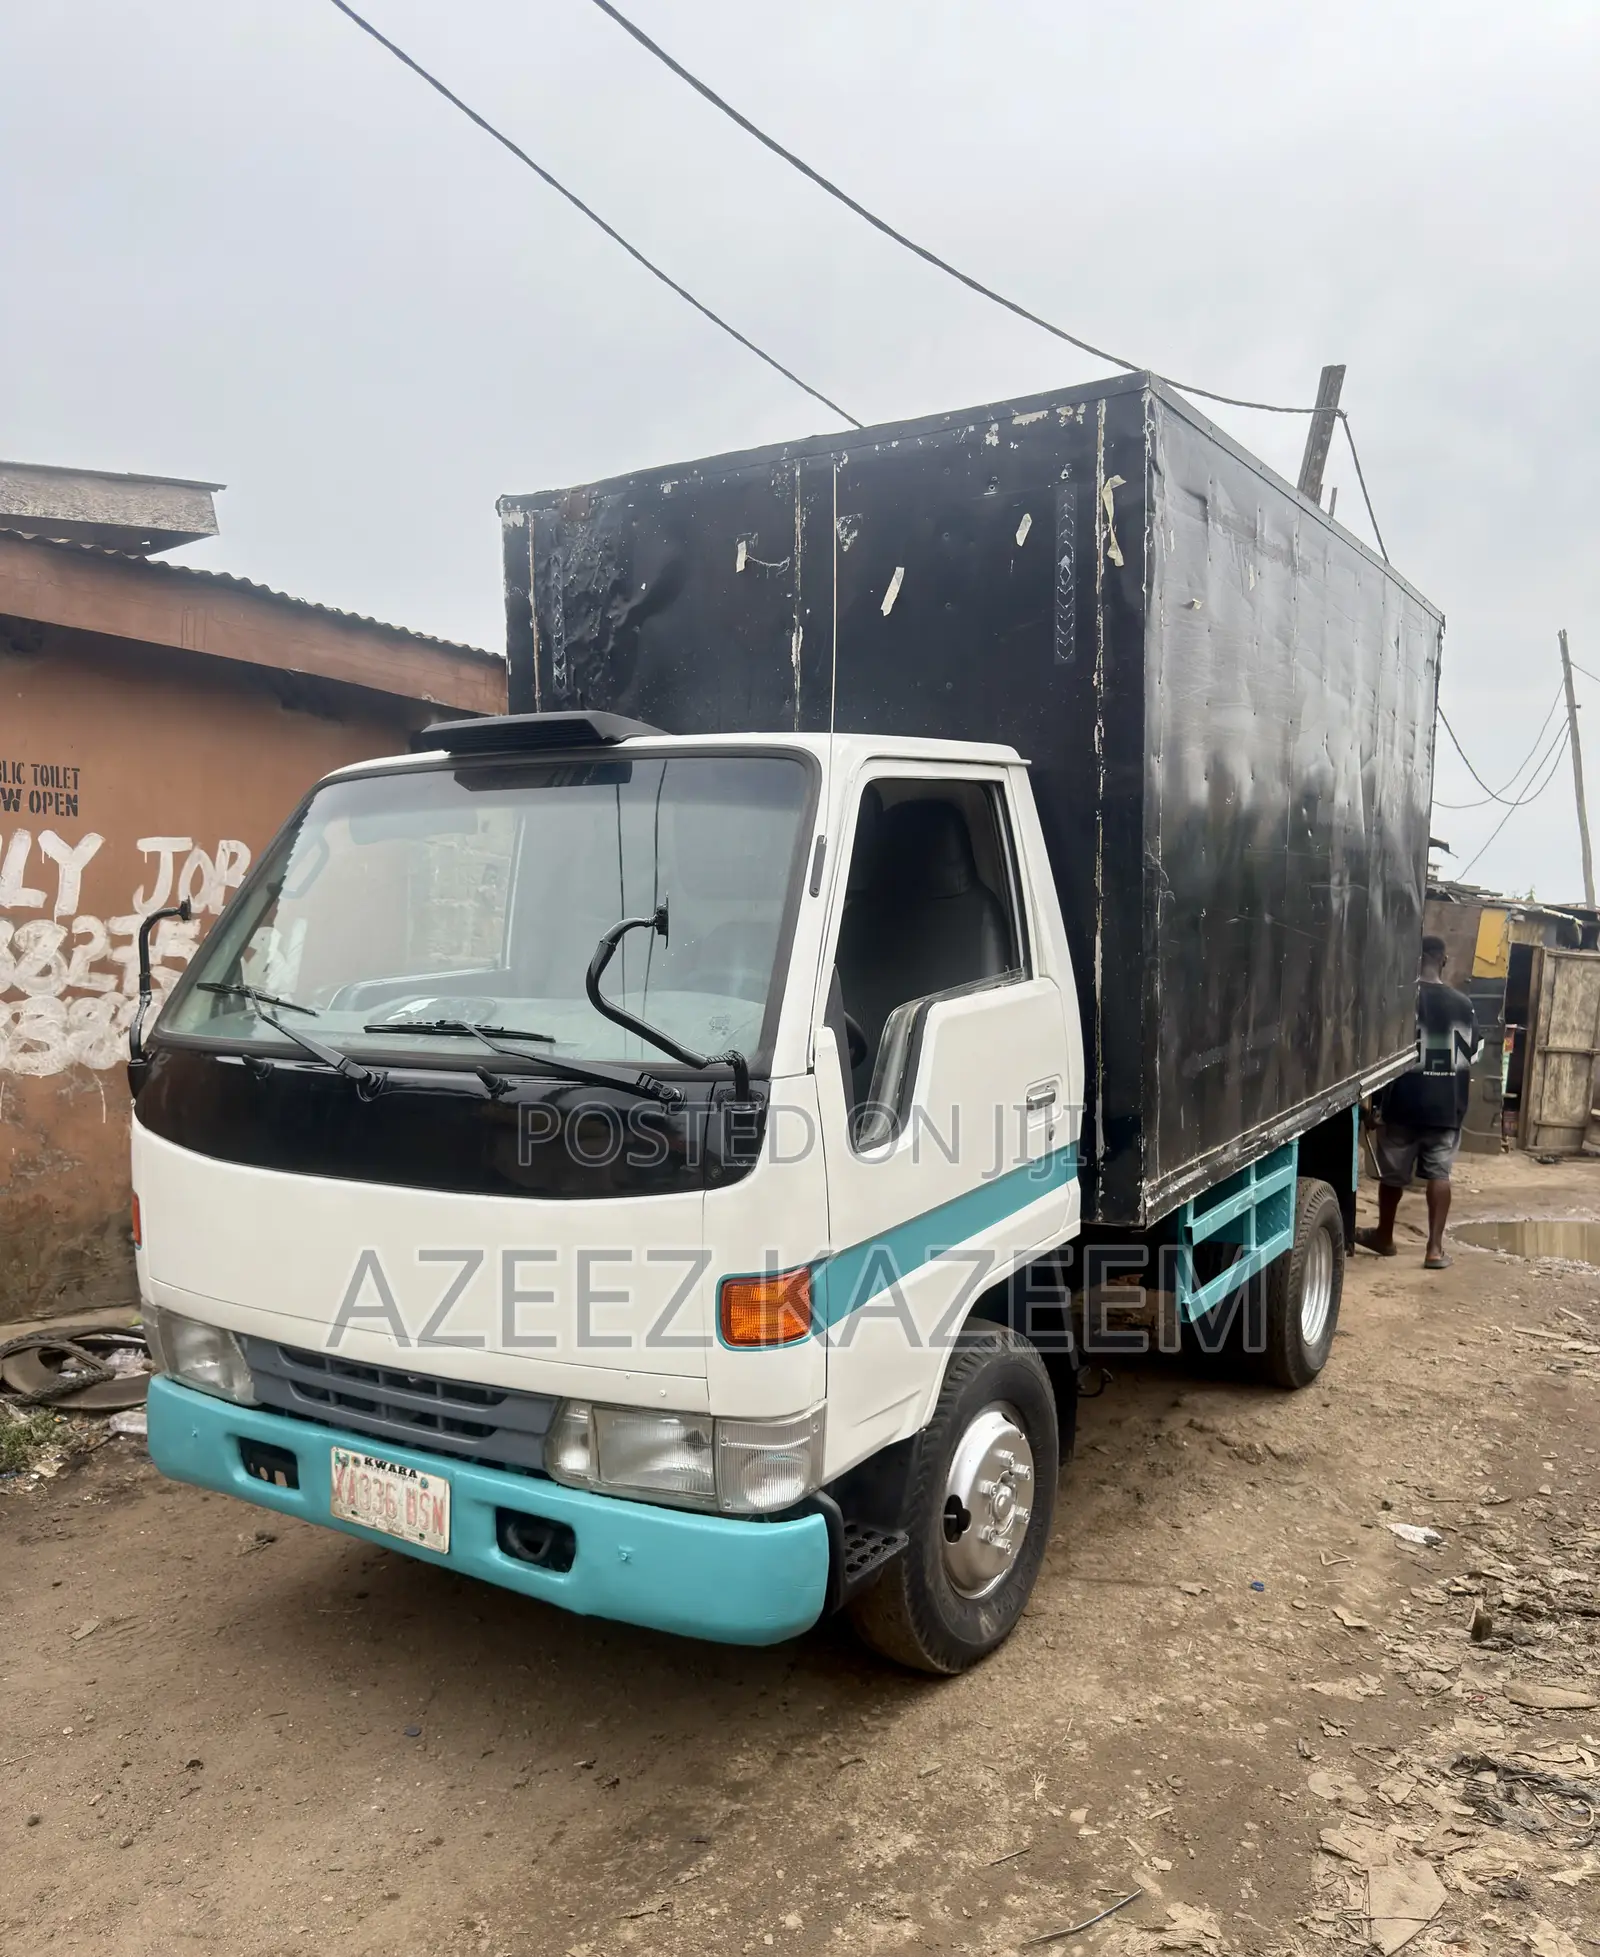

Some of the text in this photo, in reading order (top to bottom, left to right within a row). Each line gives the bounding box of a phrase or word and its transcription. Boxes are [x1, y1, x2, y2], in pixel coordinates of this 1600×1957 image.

[0, 760, 80, 790] LIC TOILET
[0, 787, 79, 817] W OPEN
[0, 827, 106, 916] LY
[363, 1457, 418, 1478] KWARA
